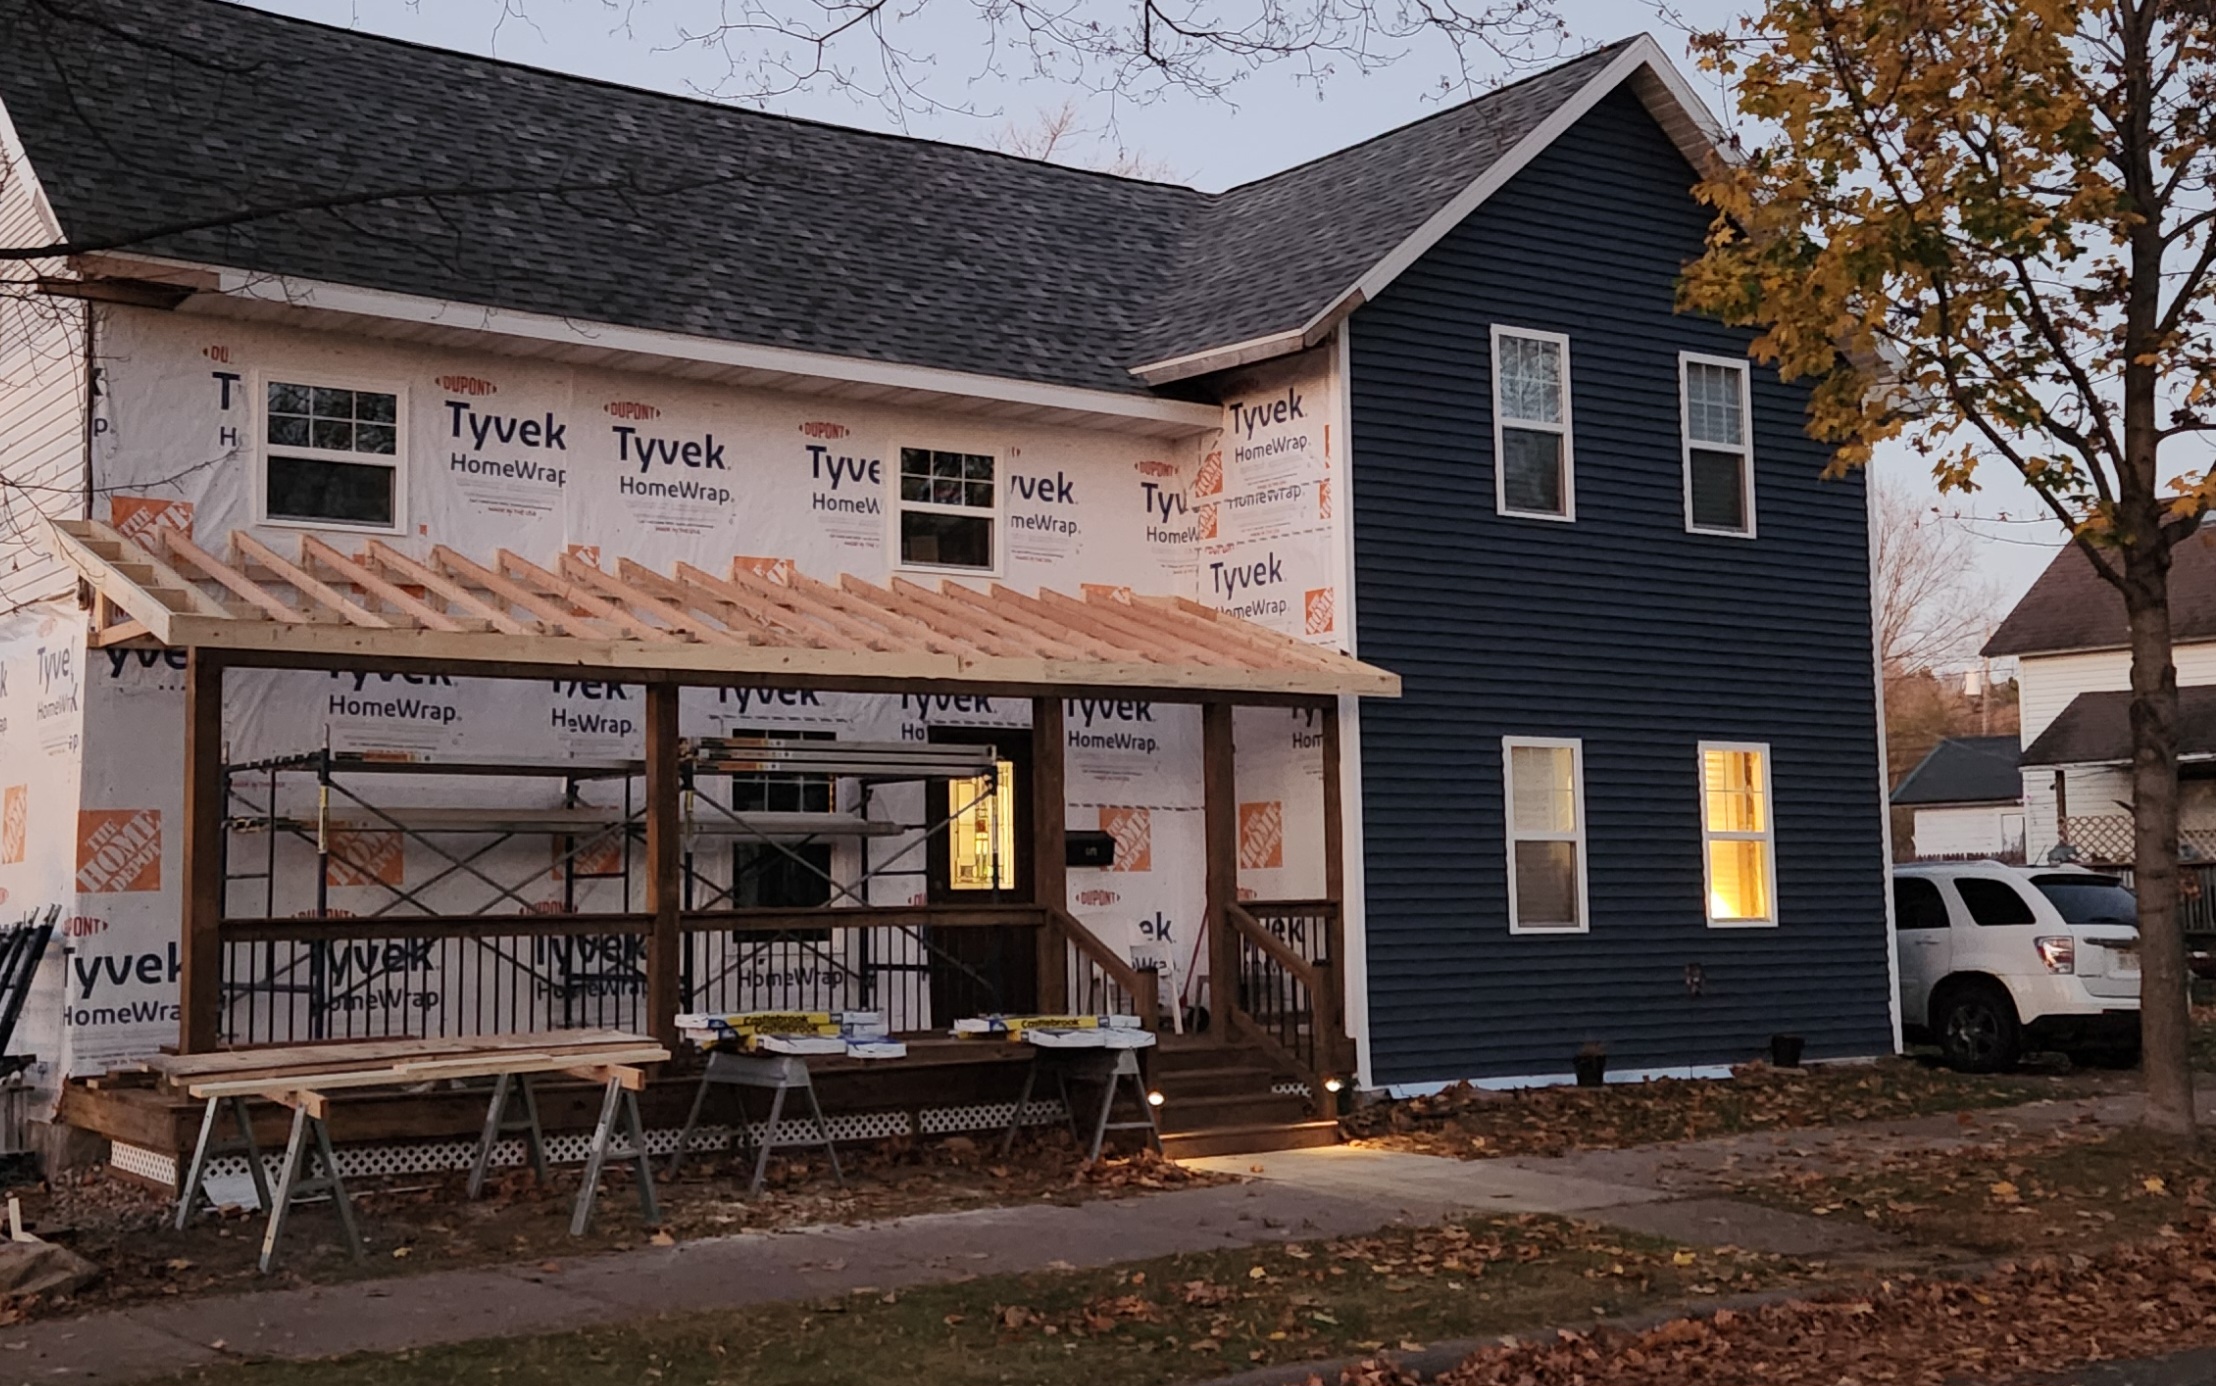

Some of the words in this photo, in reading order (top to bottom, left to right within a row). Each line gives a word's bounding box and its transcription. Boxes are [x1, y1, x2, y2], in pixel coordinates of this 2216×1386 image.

[443, 376, 492, 396] DUPONT
[445, 400, 567, 451] Tyvek
[610, 402, 656, 420] DUPONT
[1229, 387, 1304, 440] Tyvek
[804, 422, 845, 439] DUPONT
[612, 426, 726, 473] Tyvek
[1235, 436, 1308, 463] HomeWrap
[805, 445, 881, 490] Tyve
[620, 476, 730, 506] HomeWrap
[1010, 471, 1075, 504] vek
[1141, 482, 1188, 523] Tyv
[812, 493, 881, 514] HomeW
[1011, 513, 1078, 538] meWrap
[1147, 525, 1199, 544] HomeW
[1210, 551, 1283, 600] Tyvek
[329, 695, 457, 725] HomeWrap
[1068, 730, 1156, 754] HomeWrap
[87, 819, 121, 851] THE
[76, 810, 161, 892] HOME
[318, 937, 435, 987] yvek
[64, 1001, 182, 1026] HomeWra
